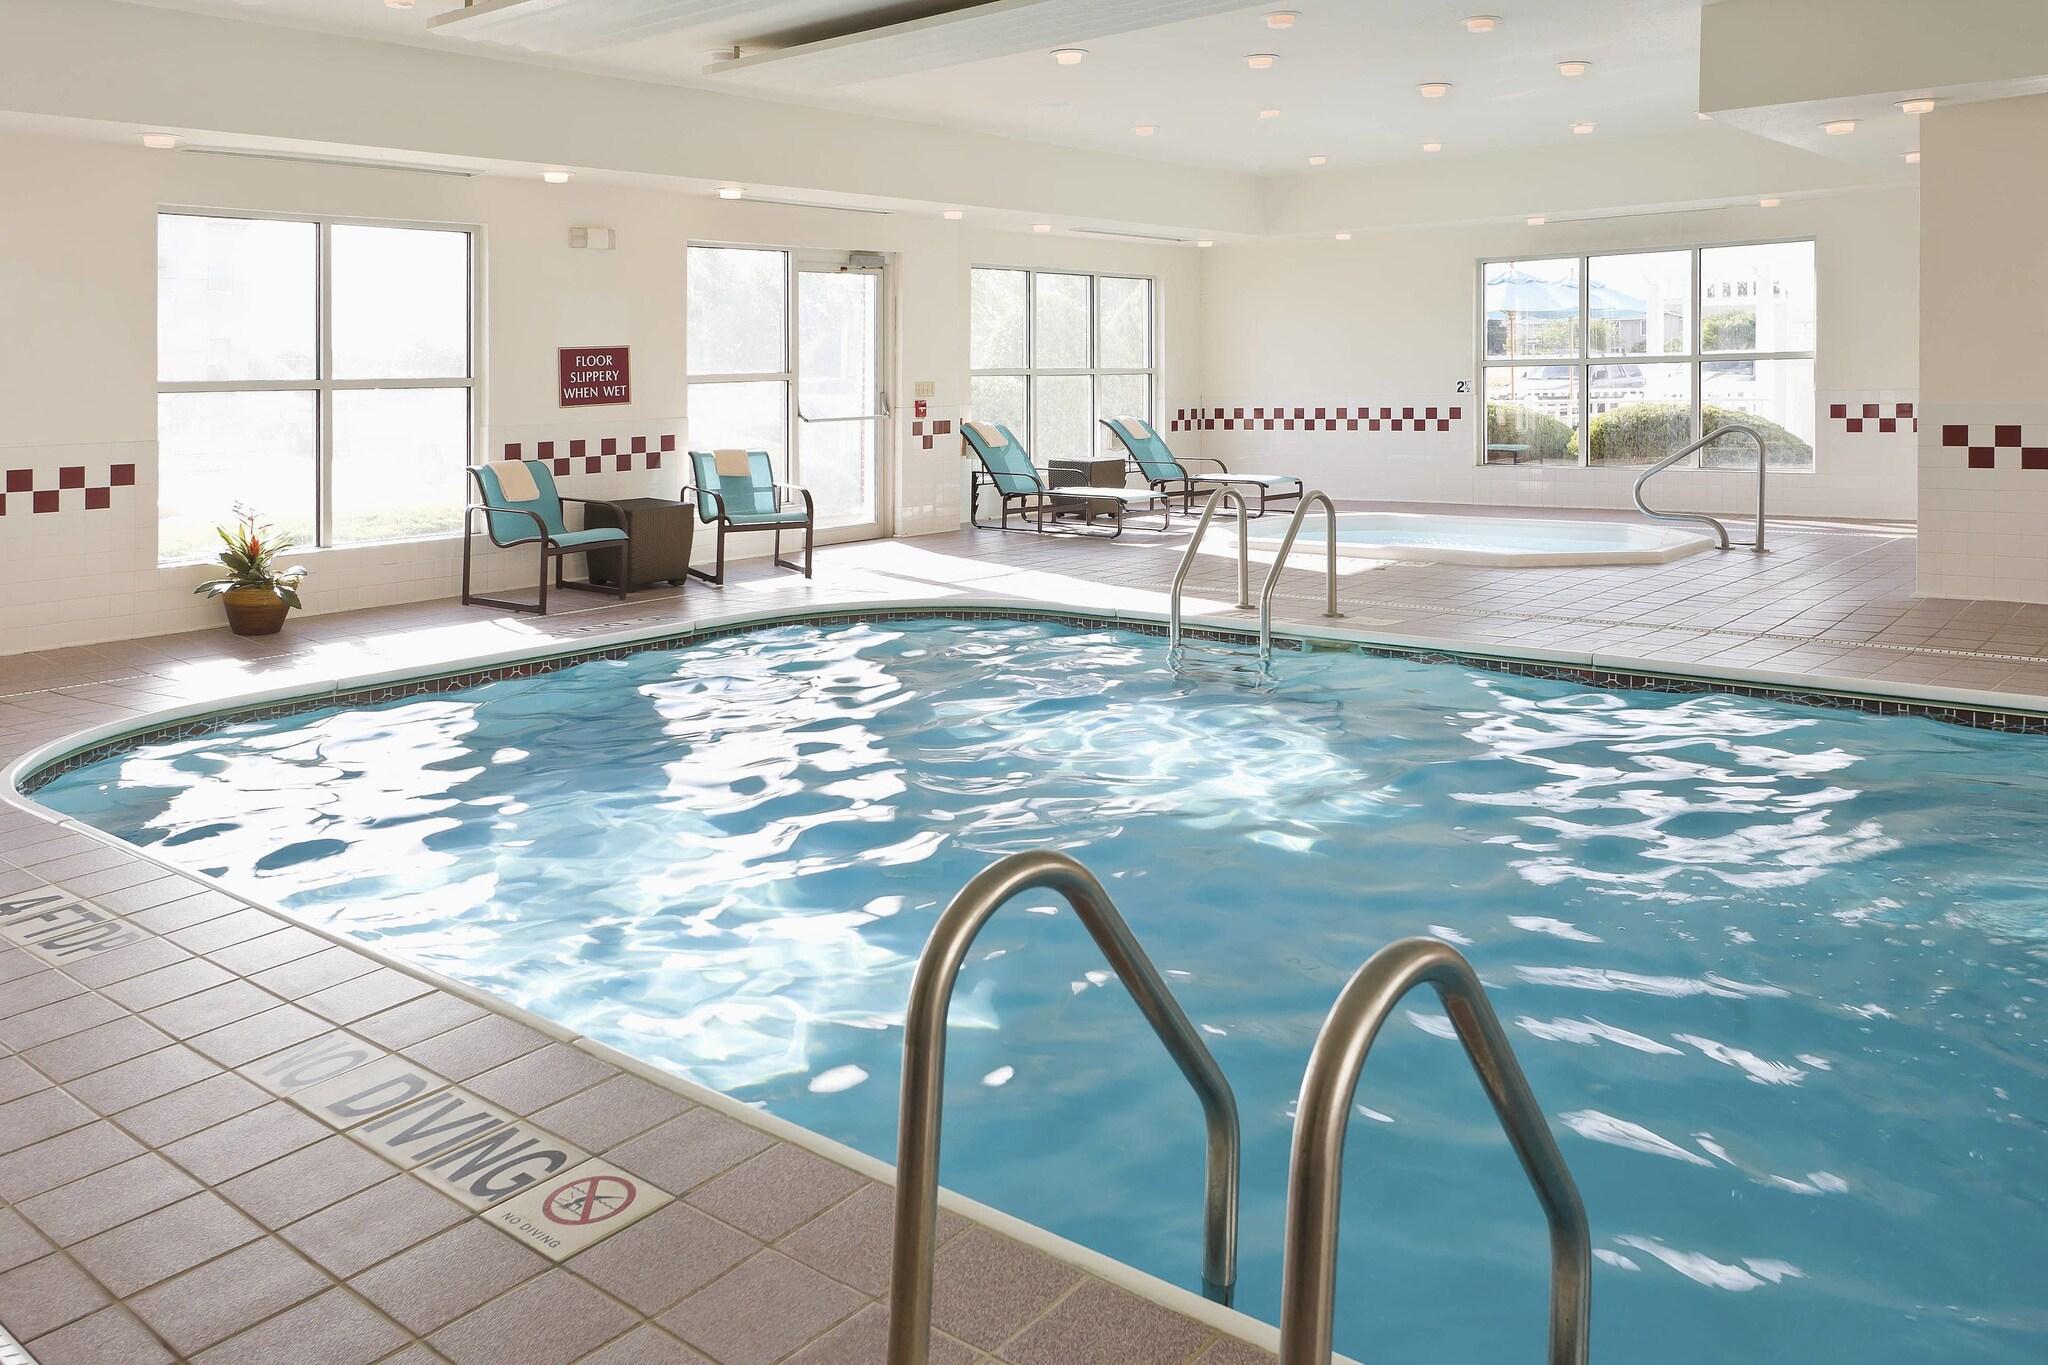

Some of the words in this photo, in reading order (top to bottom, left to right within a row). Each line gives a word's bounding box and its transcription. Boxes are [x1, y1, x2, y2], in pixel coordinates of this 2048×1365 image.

[576, 355, 613, 367] FLOOR
[570, 370, 620, 384] SLIPPERY
[563, 386, 598, 399] WHEN
[603, 385, 627, 397] WET
[262, 1034, 369, 1087] NO
[325, 1073, 568, 1201] DIVING
[501, 1212, 521, 1224] NO
[520, 1223, 560, 1248] DIVING
